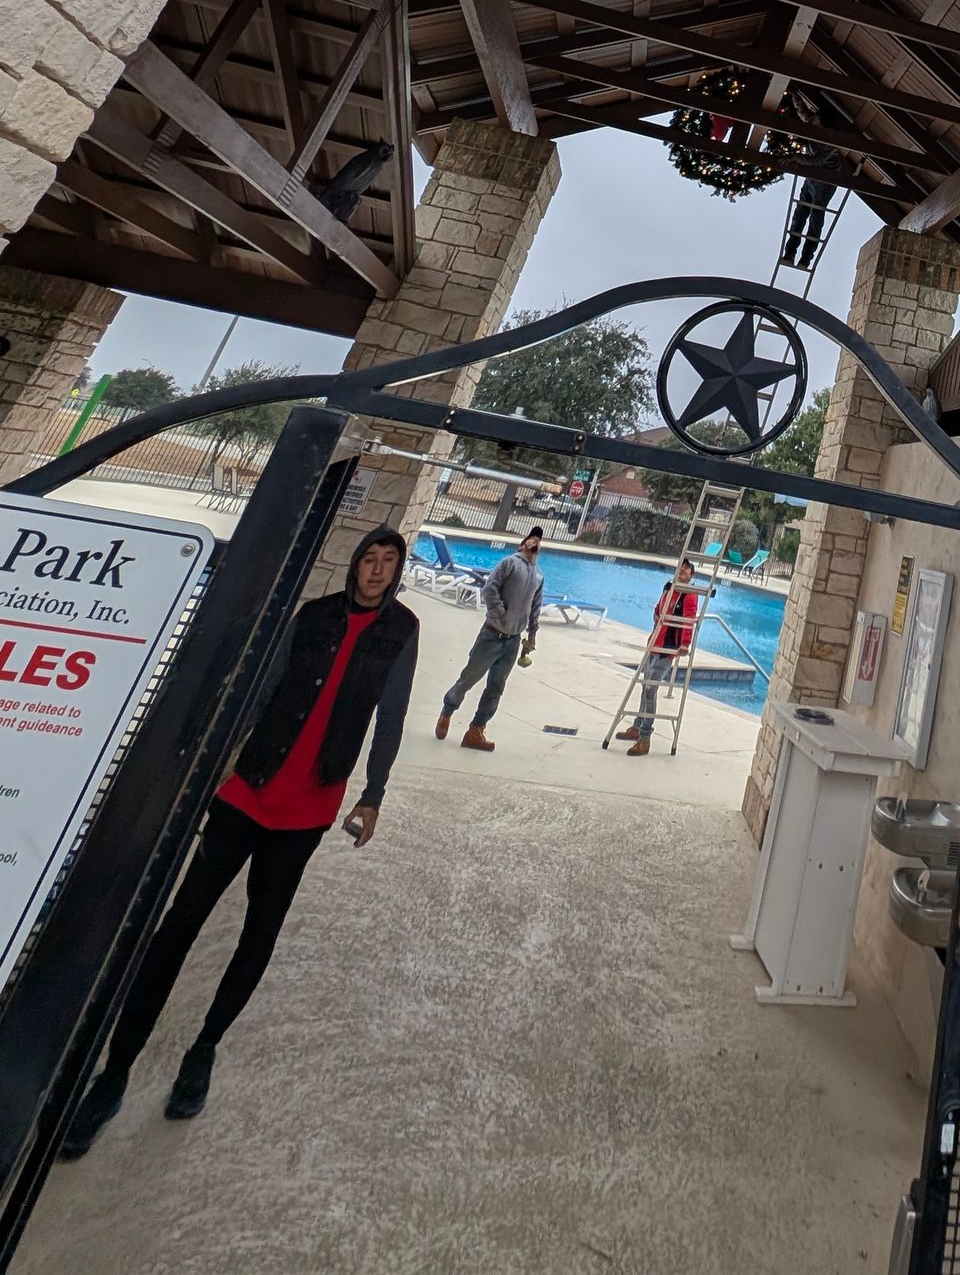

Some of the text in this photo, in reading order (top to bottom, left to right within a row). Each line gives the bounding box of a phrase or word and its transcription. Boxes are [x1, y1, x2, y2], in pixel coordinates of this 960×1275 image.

[0, 528, 136, 588] Park
[85, 600, 130, 624] Inc.
[0, 641, 96, 690] LES
[23, 702, 67, 716] related
[68, 707, 81, 718] to
[17, 719, 83, 737] guideance
